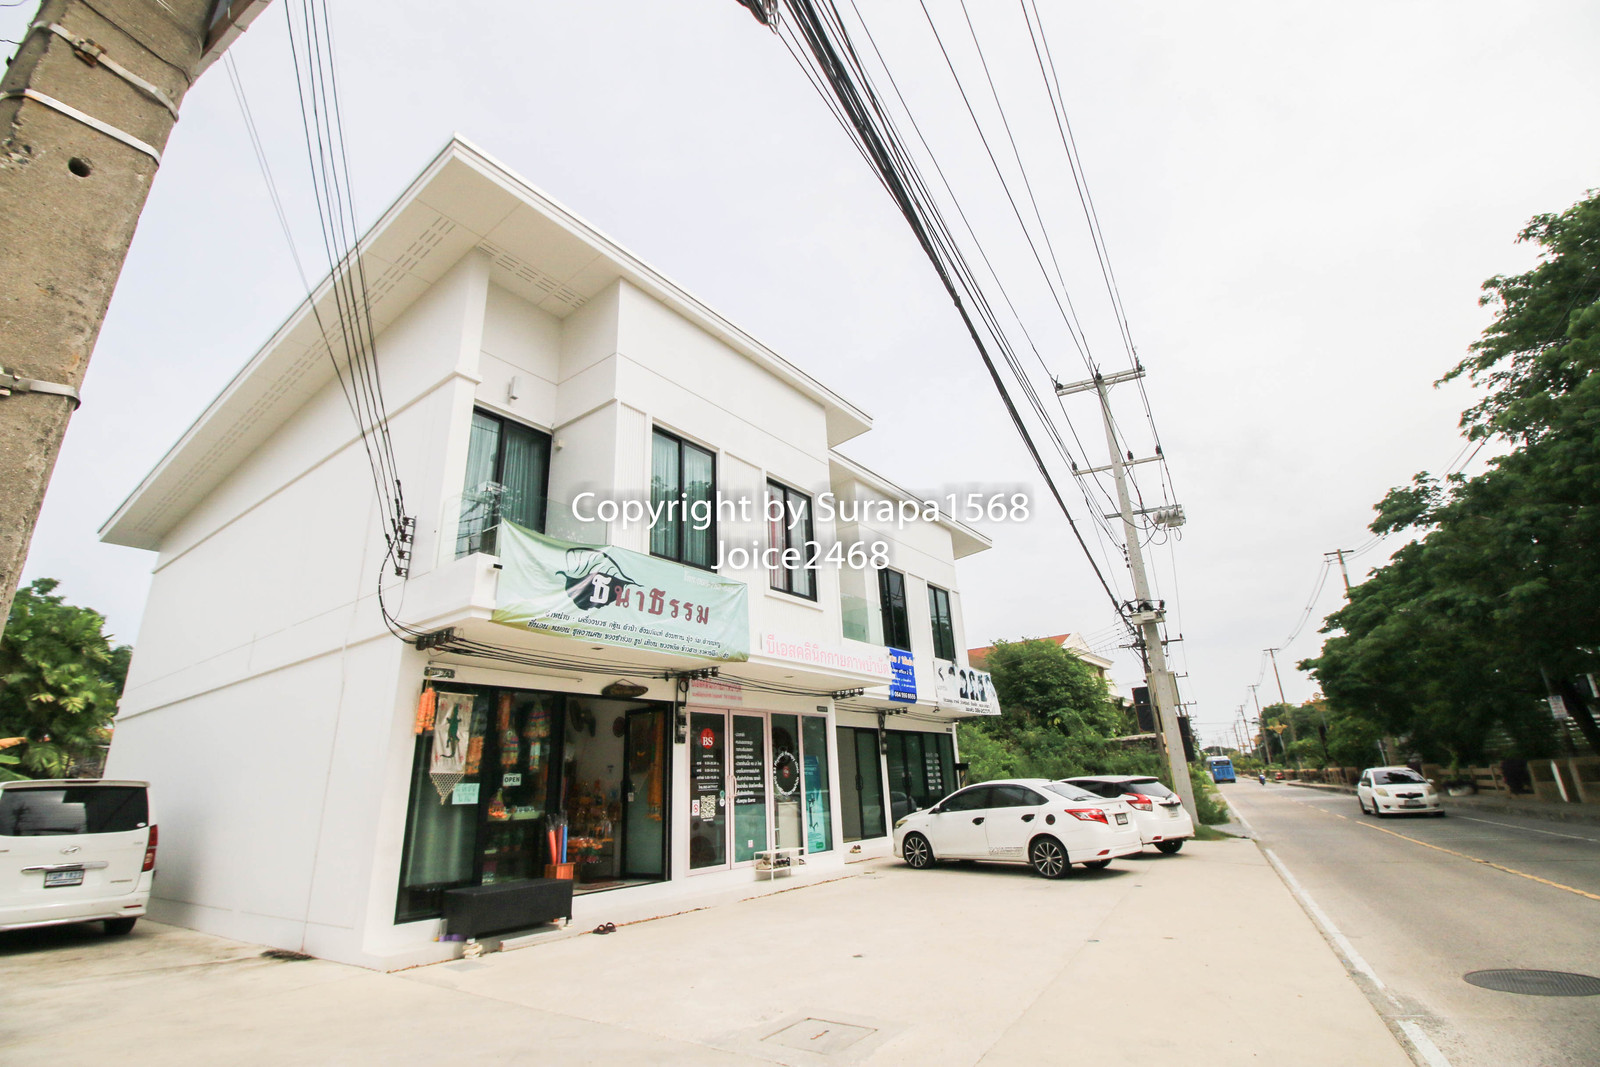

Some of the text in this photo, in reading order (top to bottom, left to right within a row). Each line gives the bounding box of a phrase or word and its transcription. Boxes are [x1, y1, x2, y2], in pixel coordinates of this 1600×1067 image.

[590, 573, 710, 625] ธนาธรรม
[702, 736, 713, 746] BS
